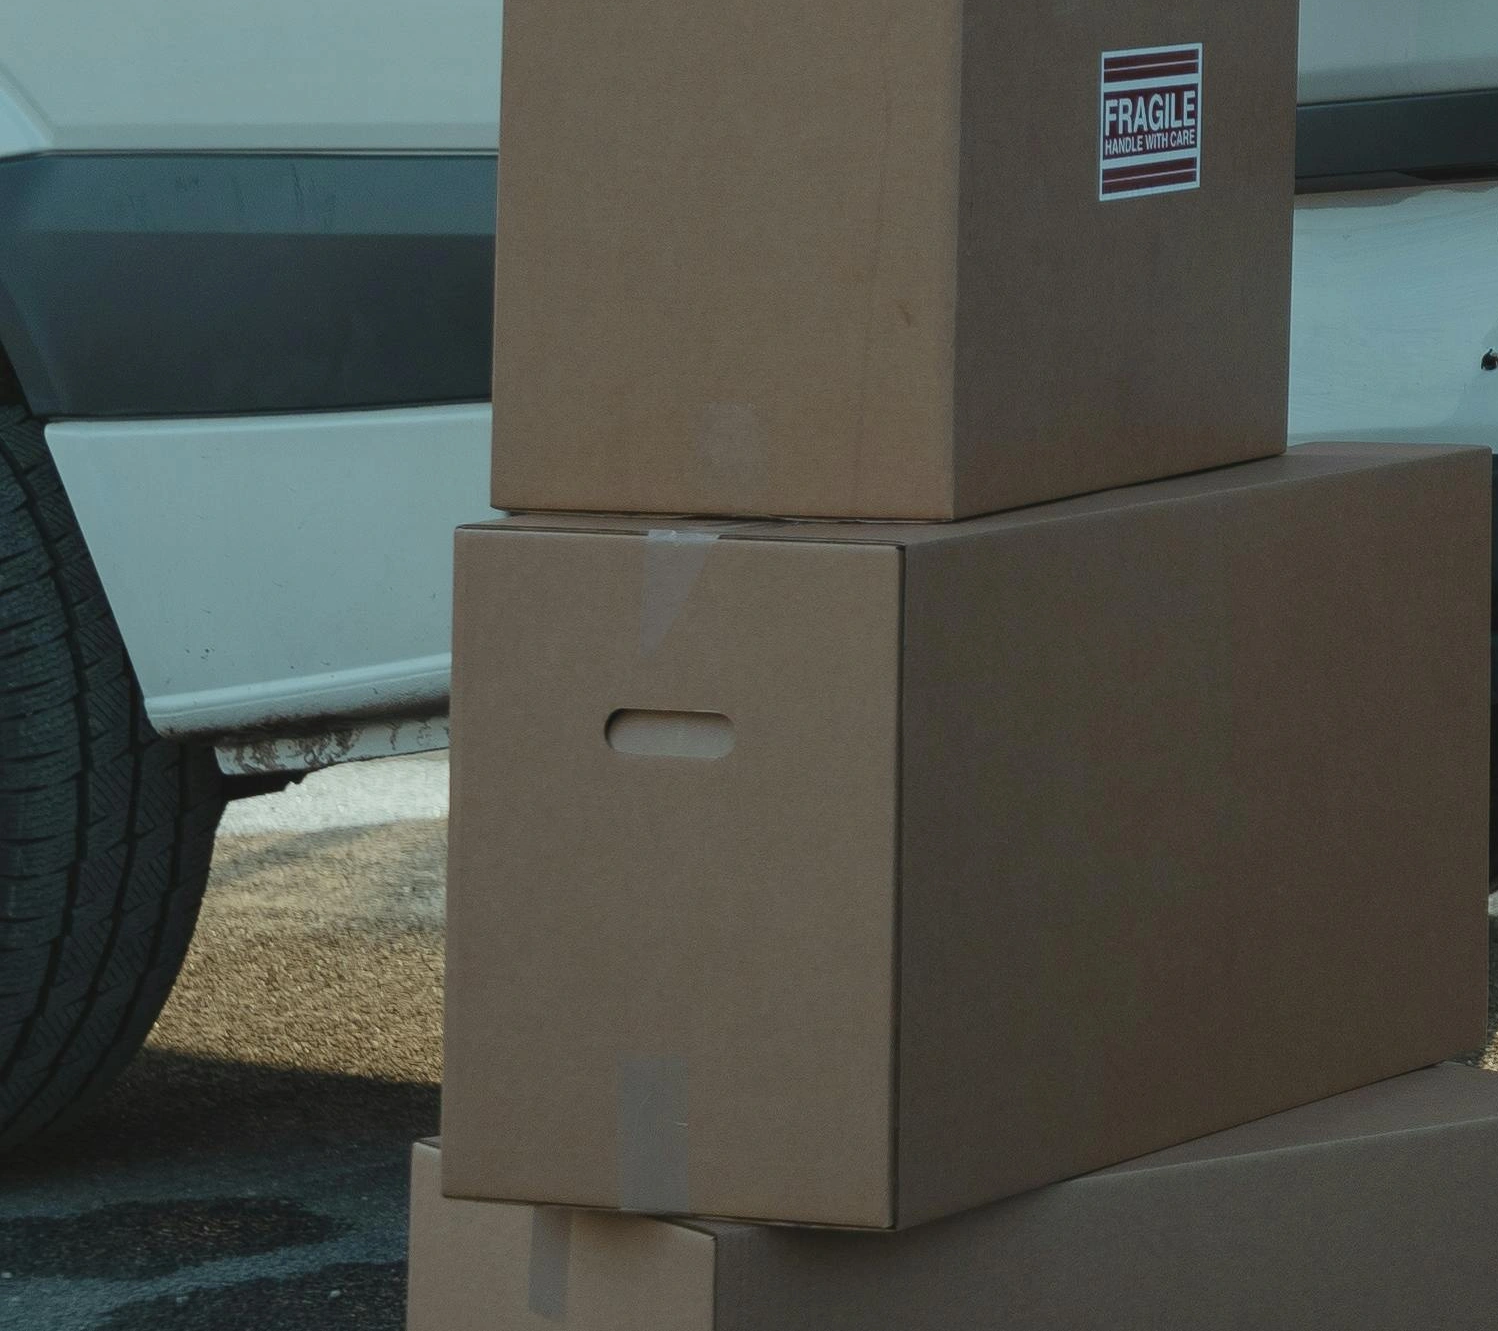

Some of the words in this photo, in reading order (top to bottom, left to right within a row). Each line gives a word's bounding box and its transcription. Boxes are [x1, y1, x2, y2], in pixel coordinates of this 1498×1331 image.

[1105, 90, 1196, 136] FRAGILE
[1105, 135, 1143, 155] HANDLE
[1145, 132, 1168, 150] WITH
[1169, 129, 1195, 146] CARE
